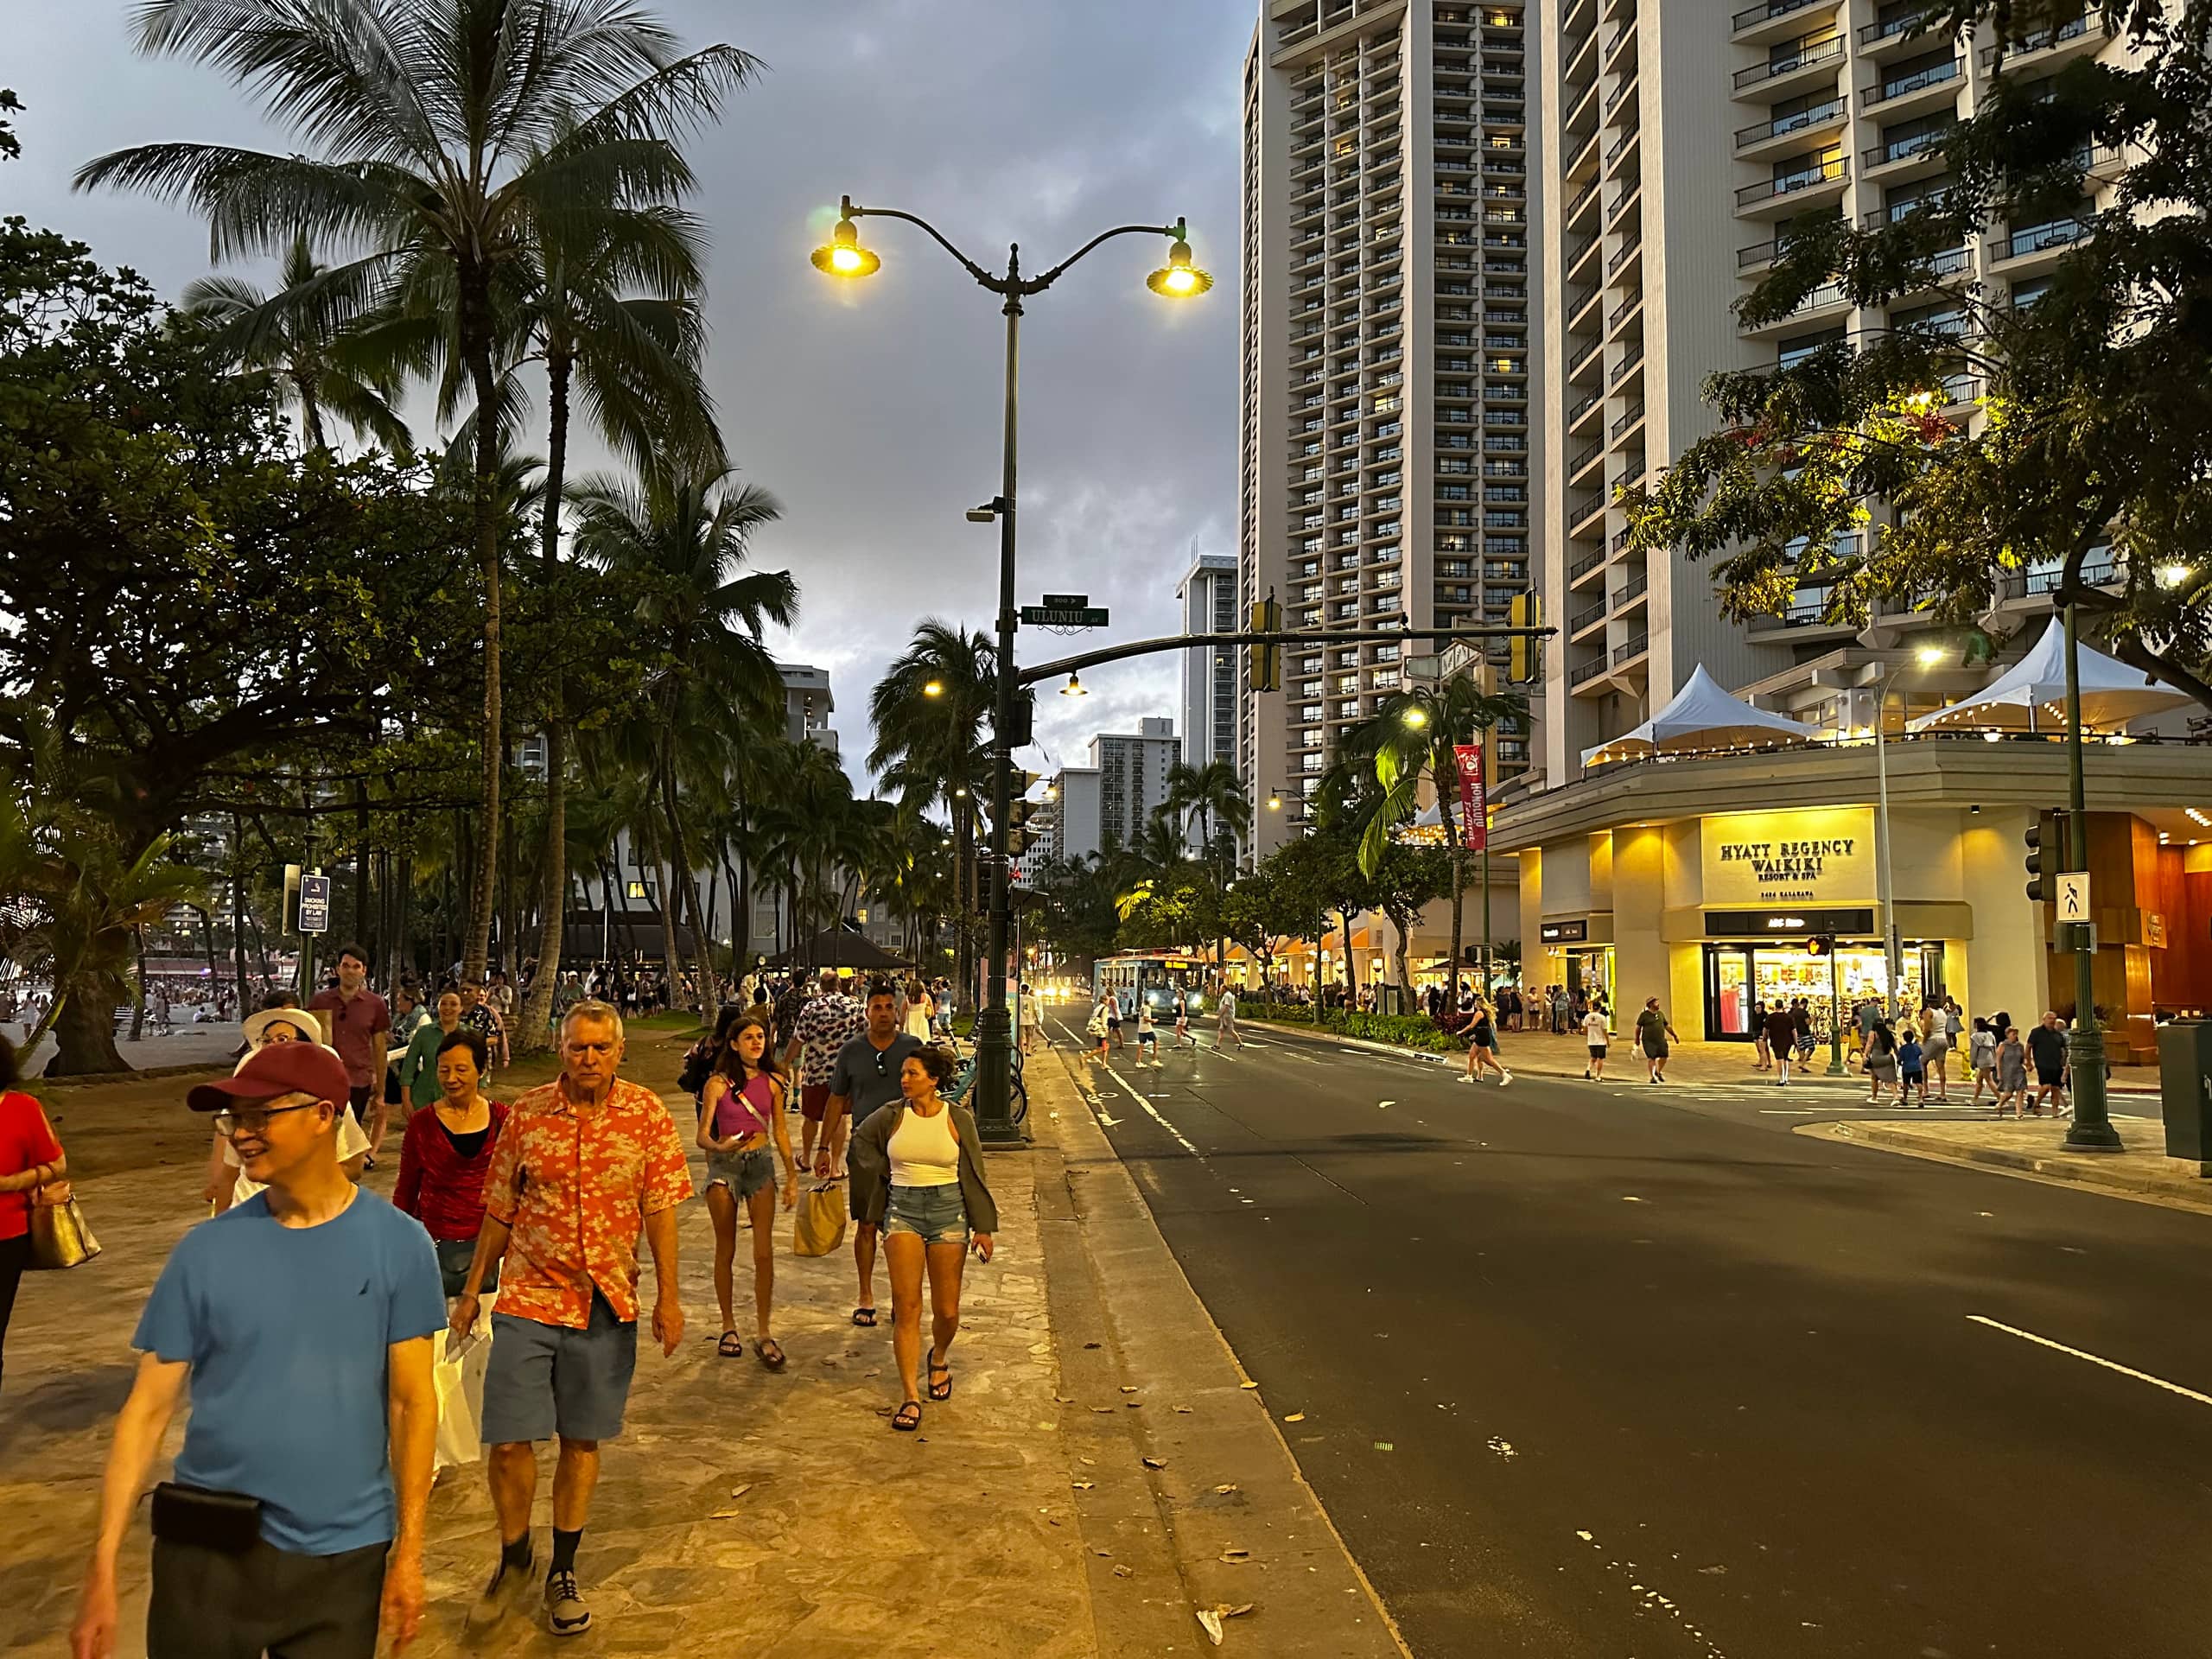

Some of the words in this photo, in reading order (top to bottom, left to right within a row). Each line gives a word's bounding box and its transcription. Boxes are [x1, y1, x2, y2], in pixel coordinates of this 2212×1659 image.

[1031, 609, 1084, 623] ULUNIU
[1471, 782, 1484, 828] HONOLULU
[1721, 843, 1771, 860] HYATT
[1781, 840, 1854, 856] REGENCY
[1751, 857, 1822, 873] WAIKIKI
[1758, 874, 1789, 882] RESORT
[1802, 872, 1816, 880] SPA
